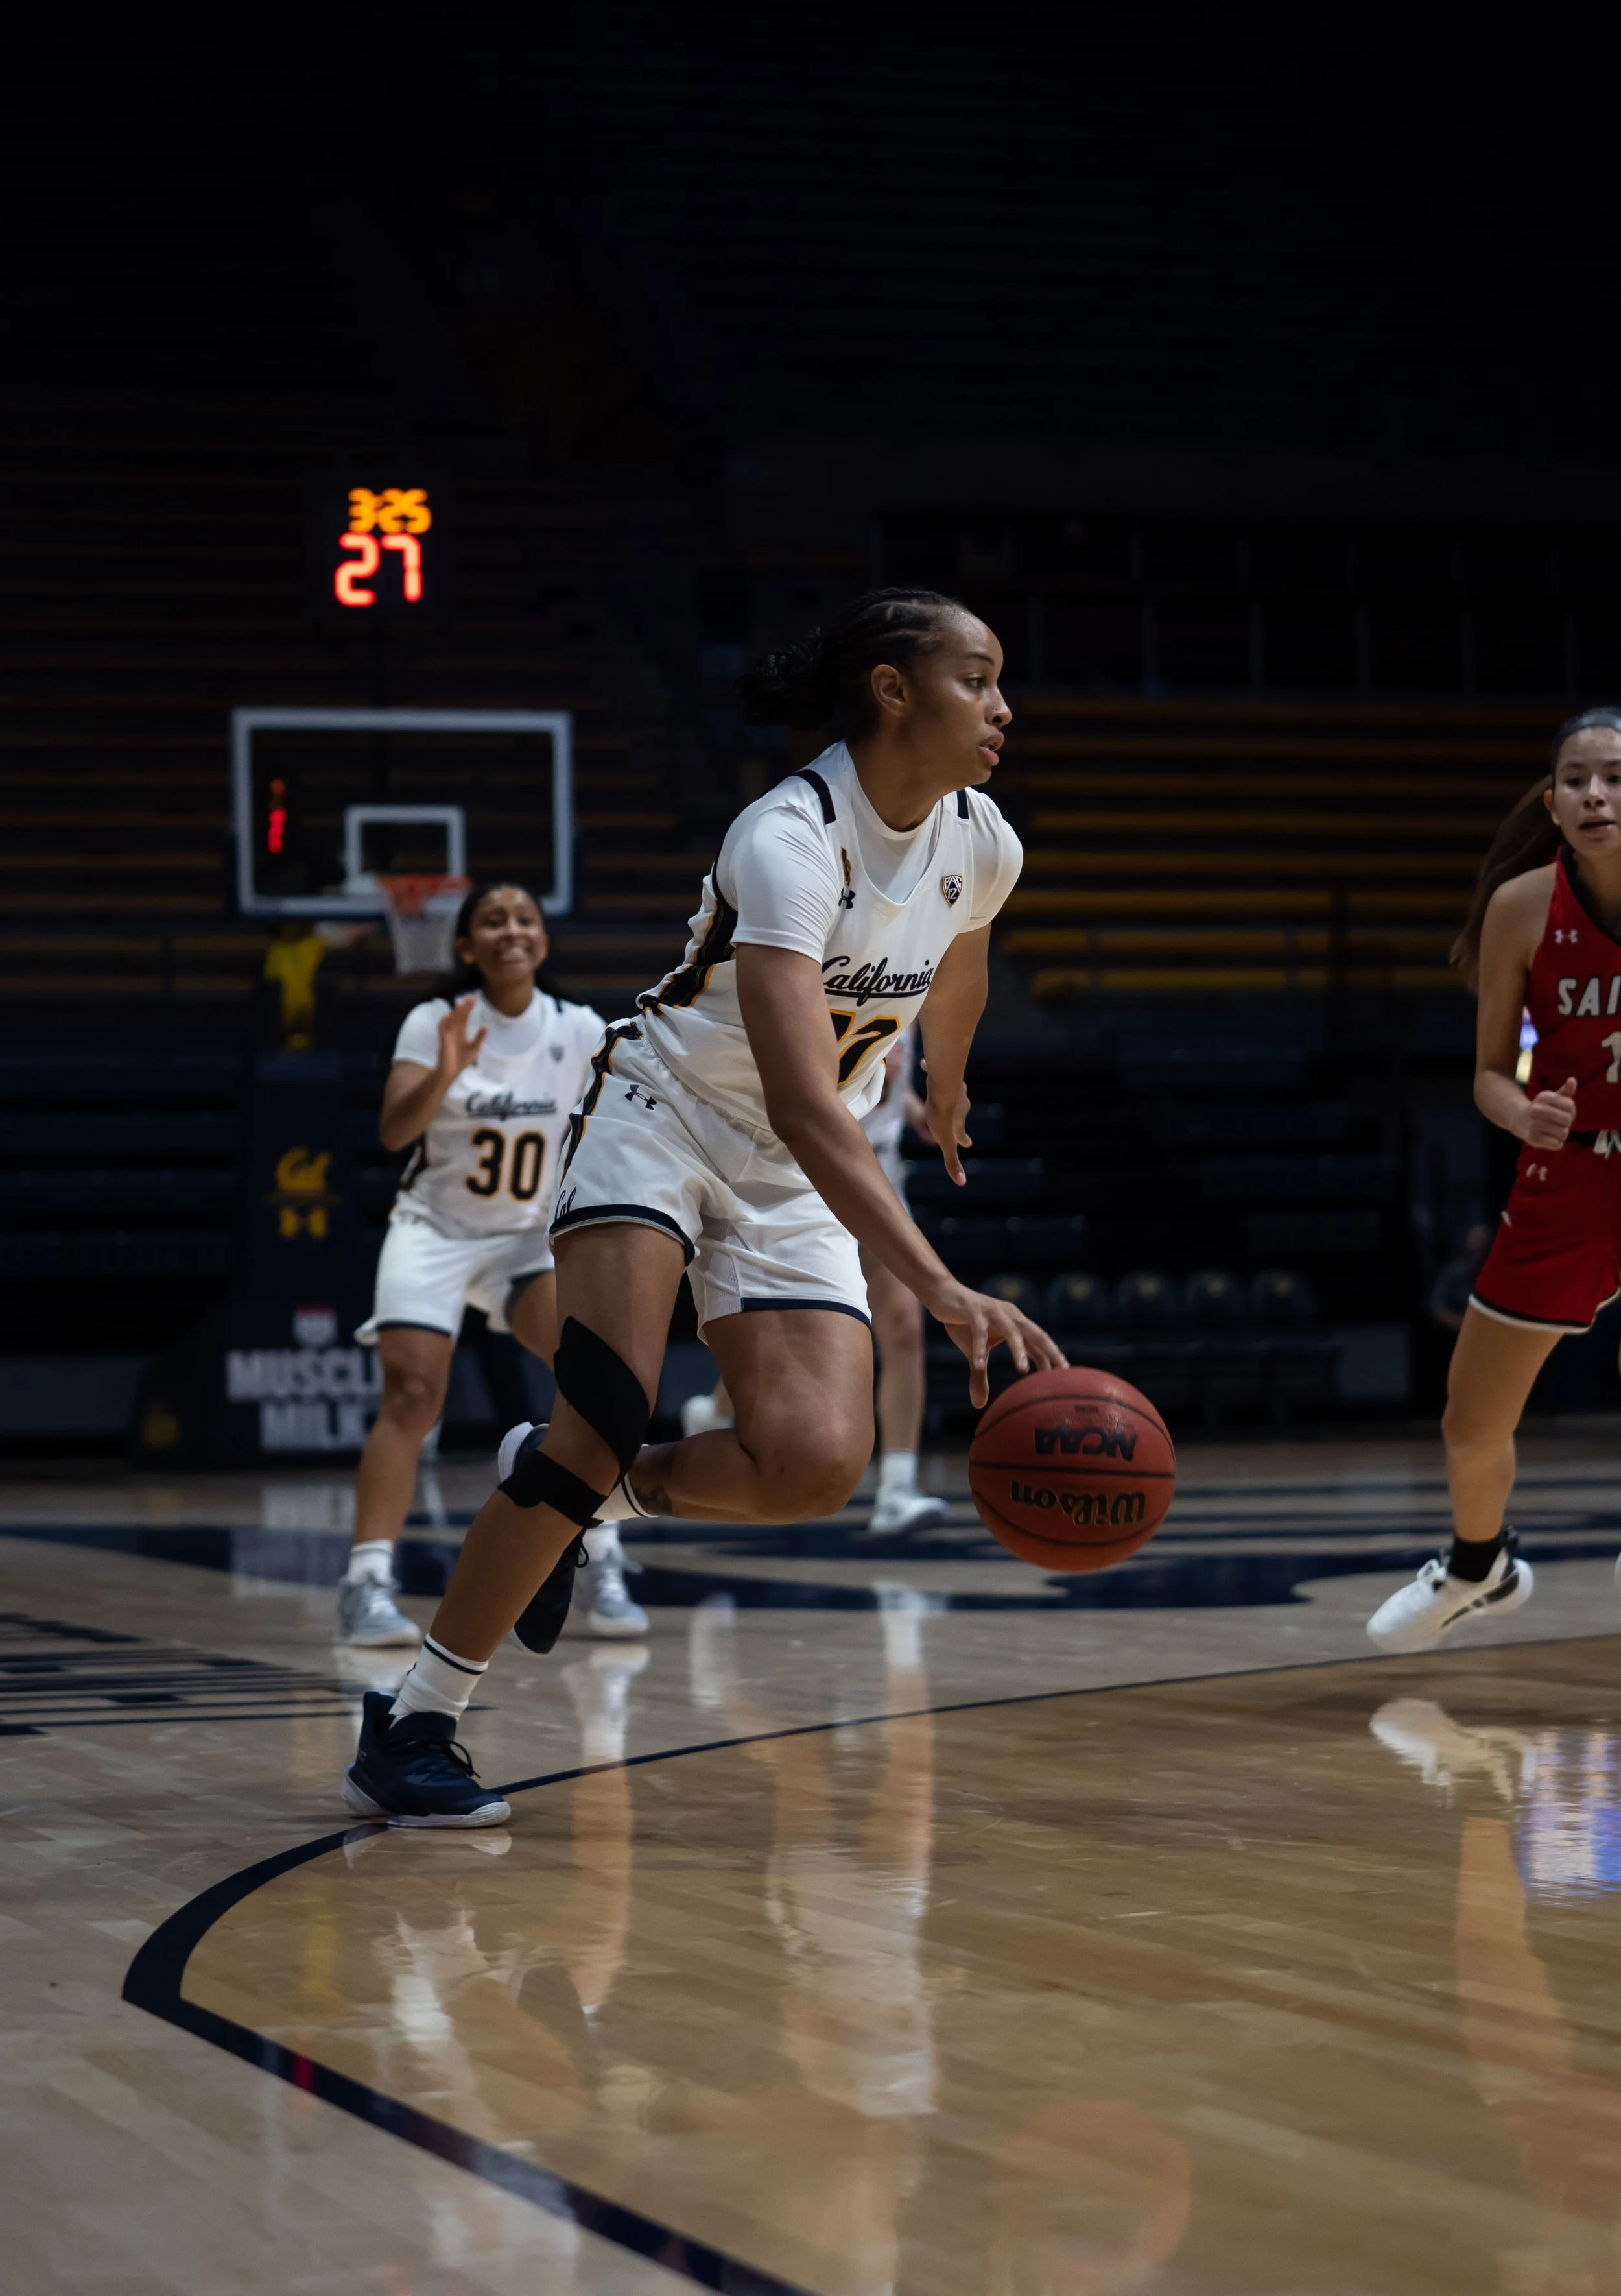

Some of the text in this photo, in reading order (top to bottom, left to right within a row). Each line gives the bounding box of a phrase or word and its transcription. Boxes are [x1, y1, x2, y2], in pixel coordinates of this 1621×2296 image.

[334, 532, 423, 608] 27
[944, 876, 962, 893] PAC
[948, 887, 958, 900] 12
[822, 955, 934, 1007] California
[466, 1129, 545, 1200] 30
[226, 1347, 384, 1401] MUSCL
[1034, 1426, 1137, 1461] NCAA
[1010, 1480, 1146, 1527] Wilson
